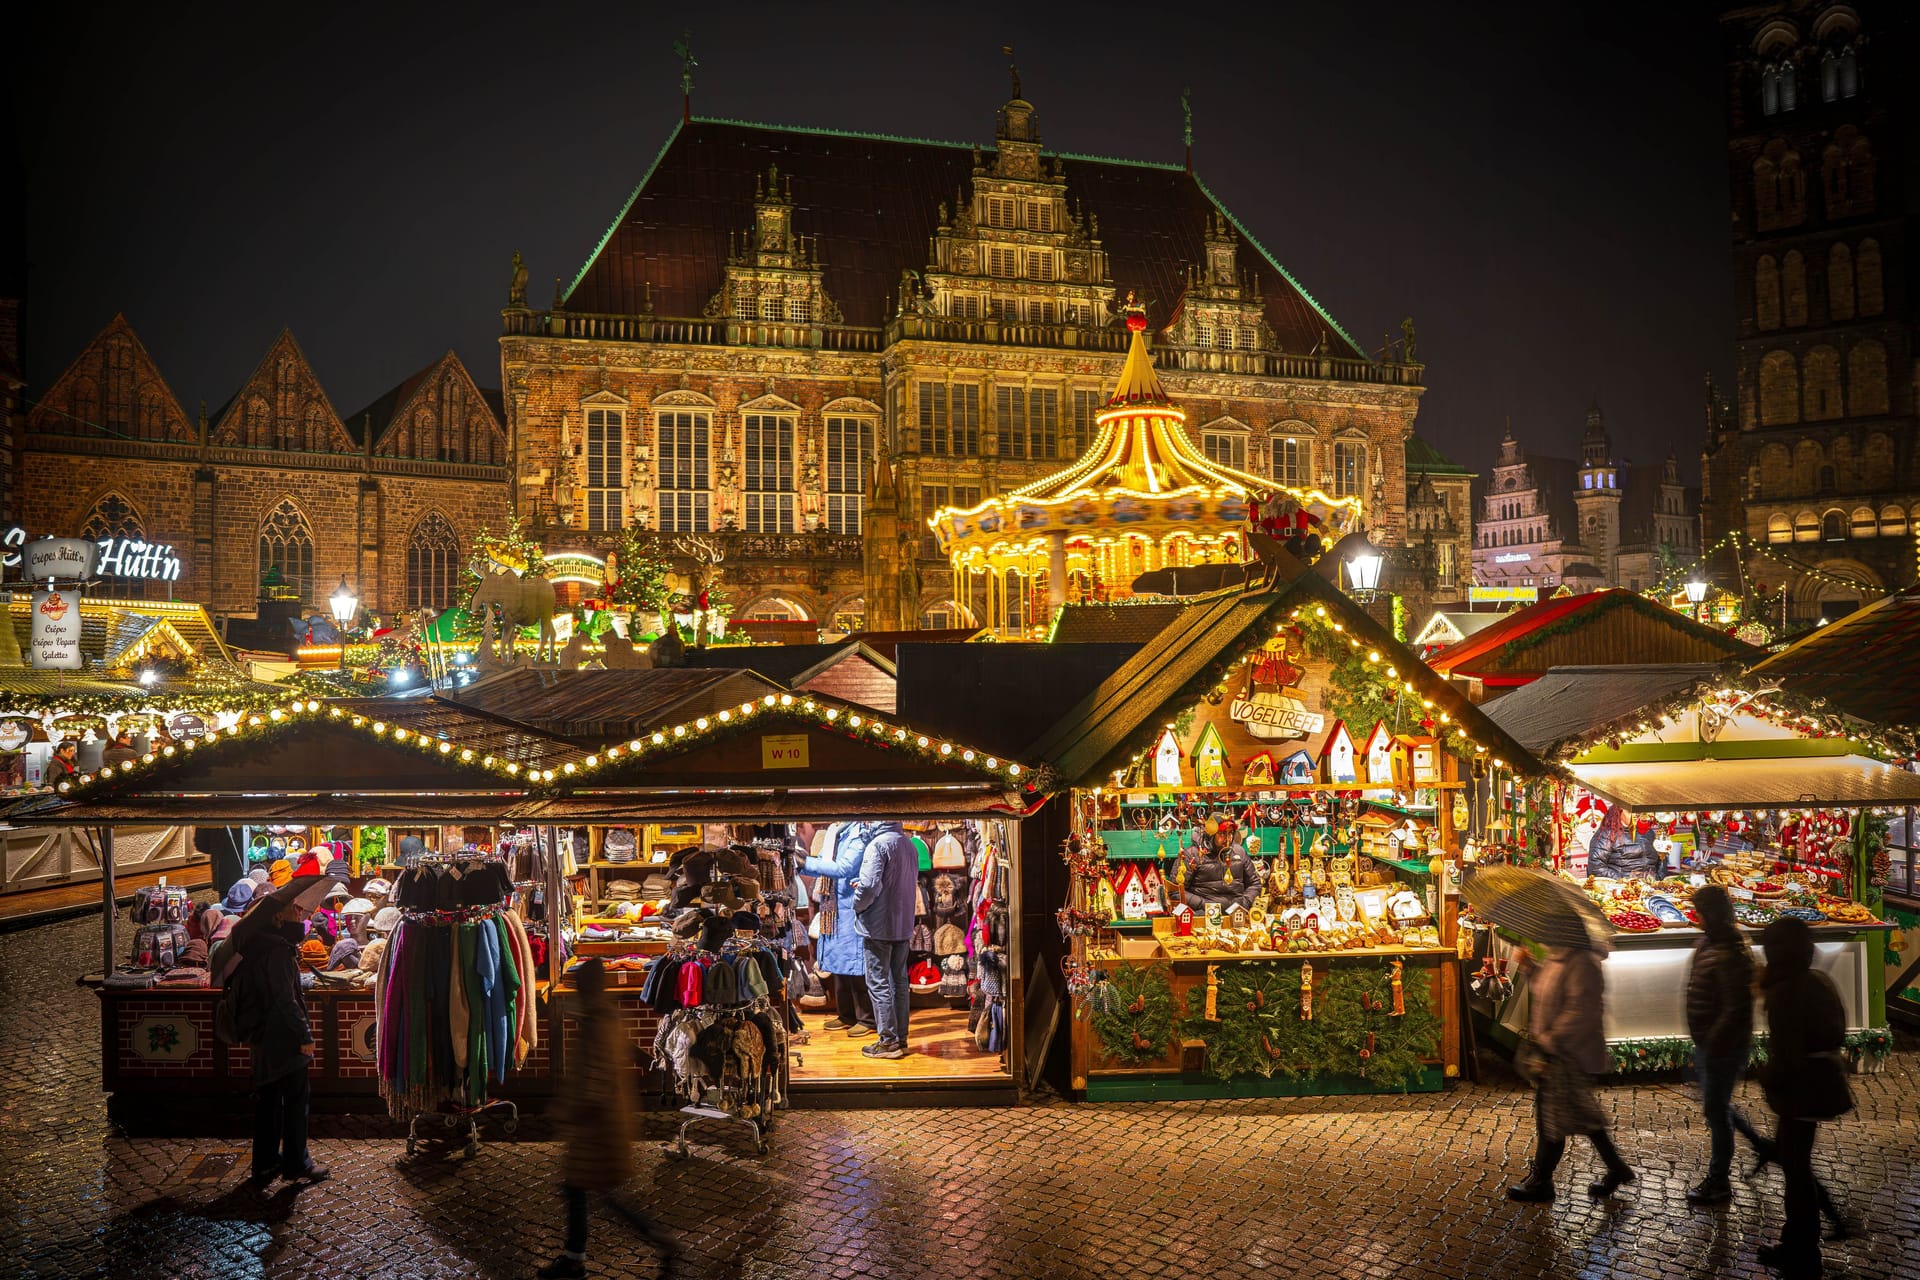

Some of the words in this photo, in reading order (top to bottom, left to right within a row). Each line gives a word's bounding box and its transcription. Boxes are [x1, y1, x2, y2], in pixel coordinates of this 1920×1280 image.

[32, 552, 56, 566] Crêpes
[96, 539, 180, 580] Hütt'n
[45, 624, 67, 635] Crêpes
[32, 637, 54, 648] Crêpes
[55, 637, 76, 648] Vegan
[41, 650, 68, 661] Galettes
[1233, 701, 1320, 730] VOGELTREFF
[772, 750, 783, 759] W
[788, 749, 800, 759] 10
